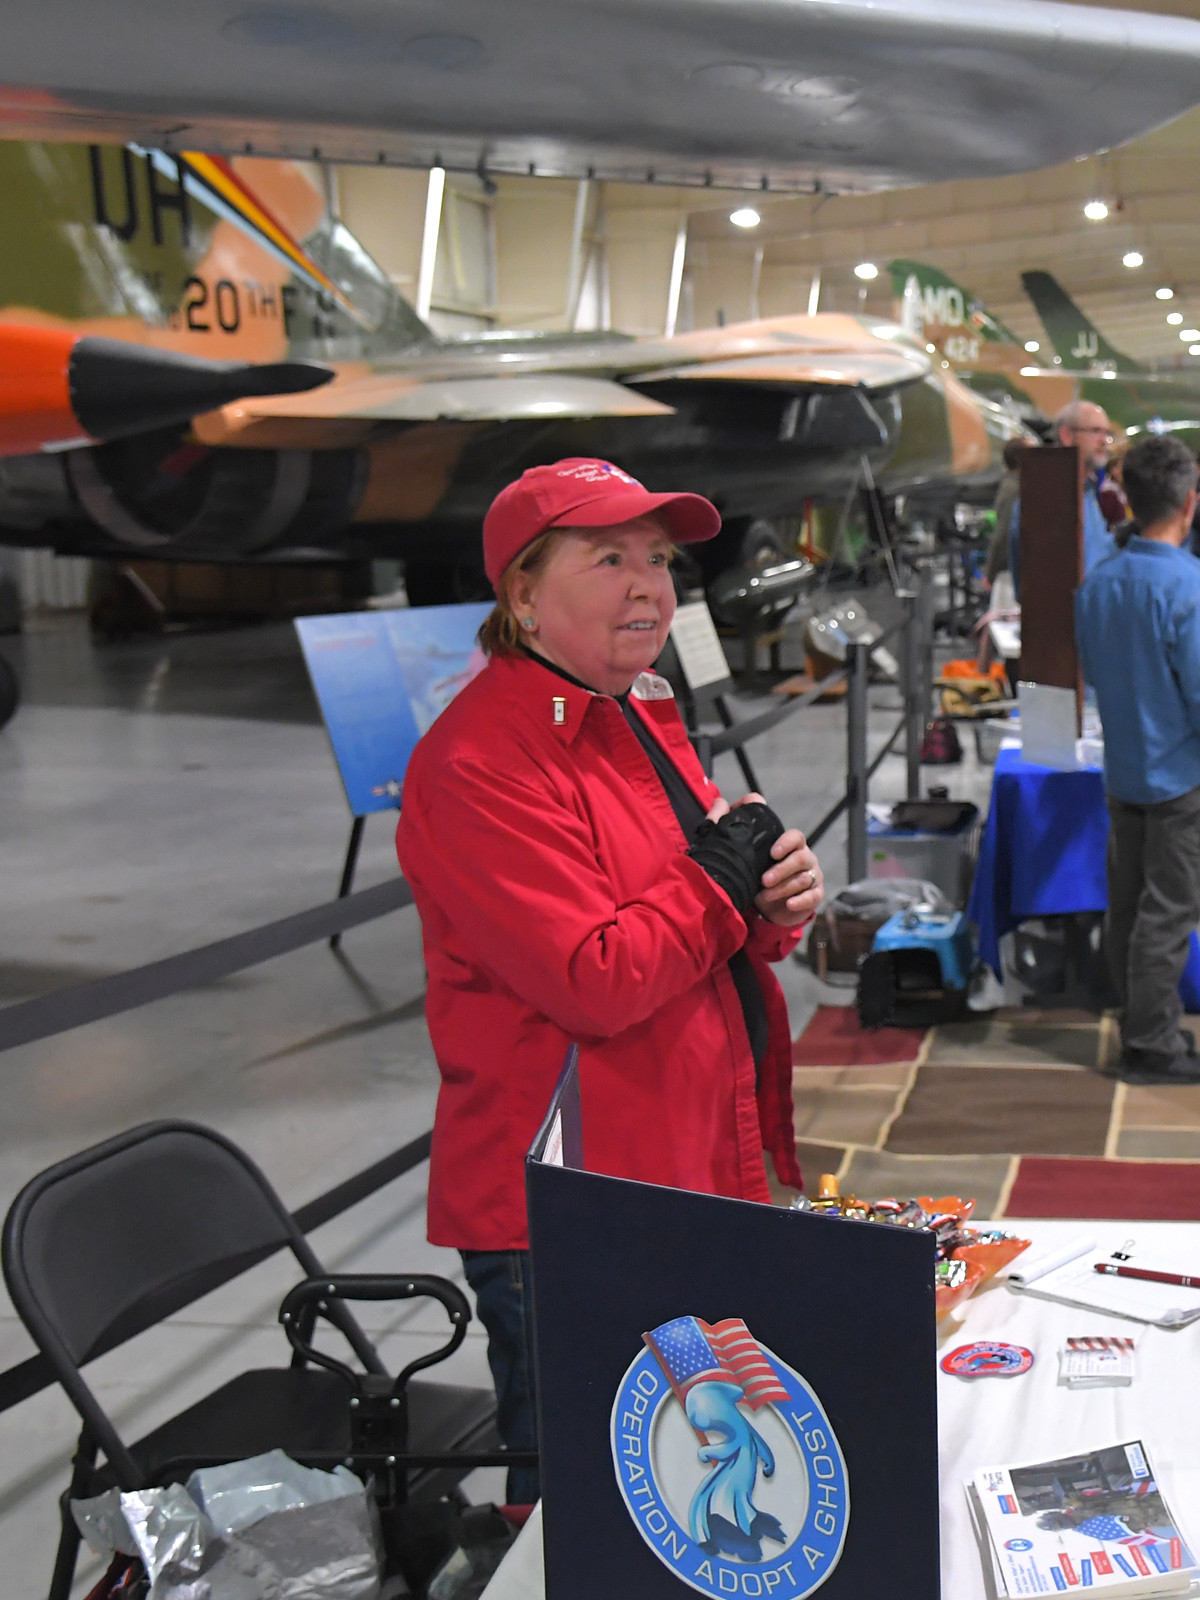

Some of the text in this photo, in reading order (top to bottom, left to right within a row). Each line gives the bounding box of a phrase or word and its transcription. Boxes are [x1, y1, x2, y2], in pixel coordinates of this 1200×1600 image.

[1071, 331, 1099, 358] JJ
[621, 1368, 839, 1597] OPERATION ADOPT A GHOST
